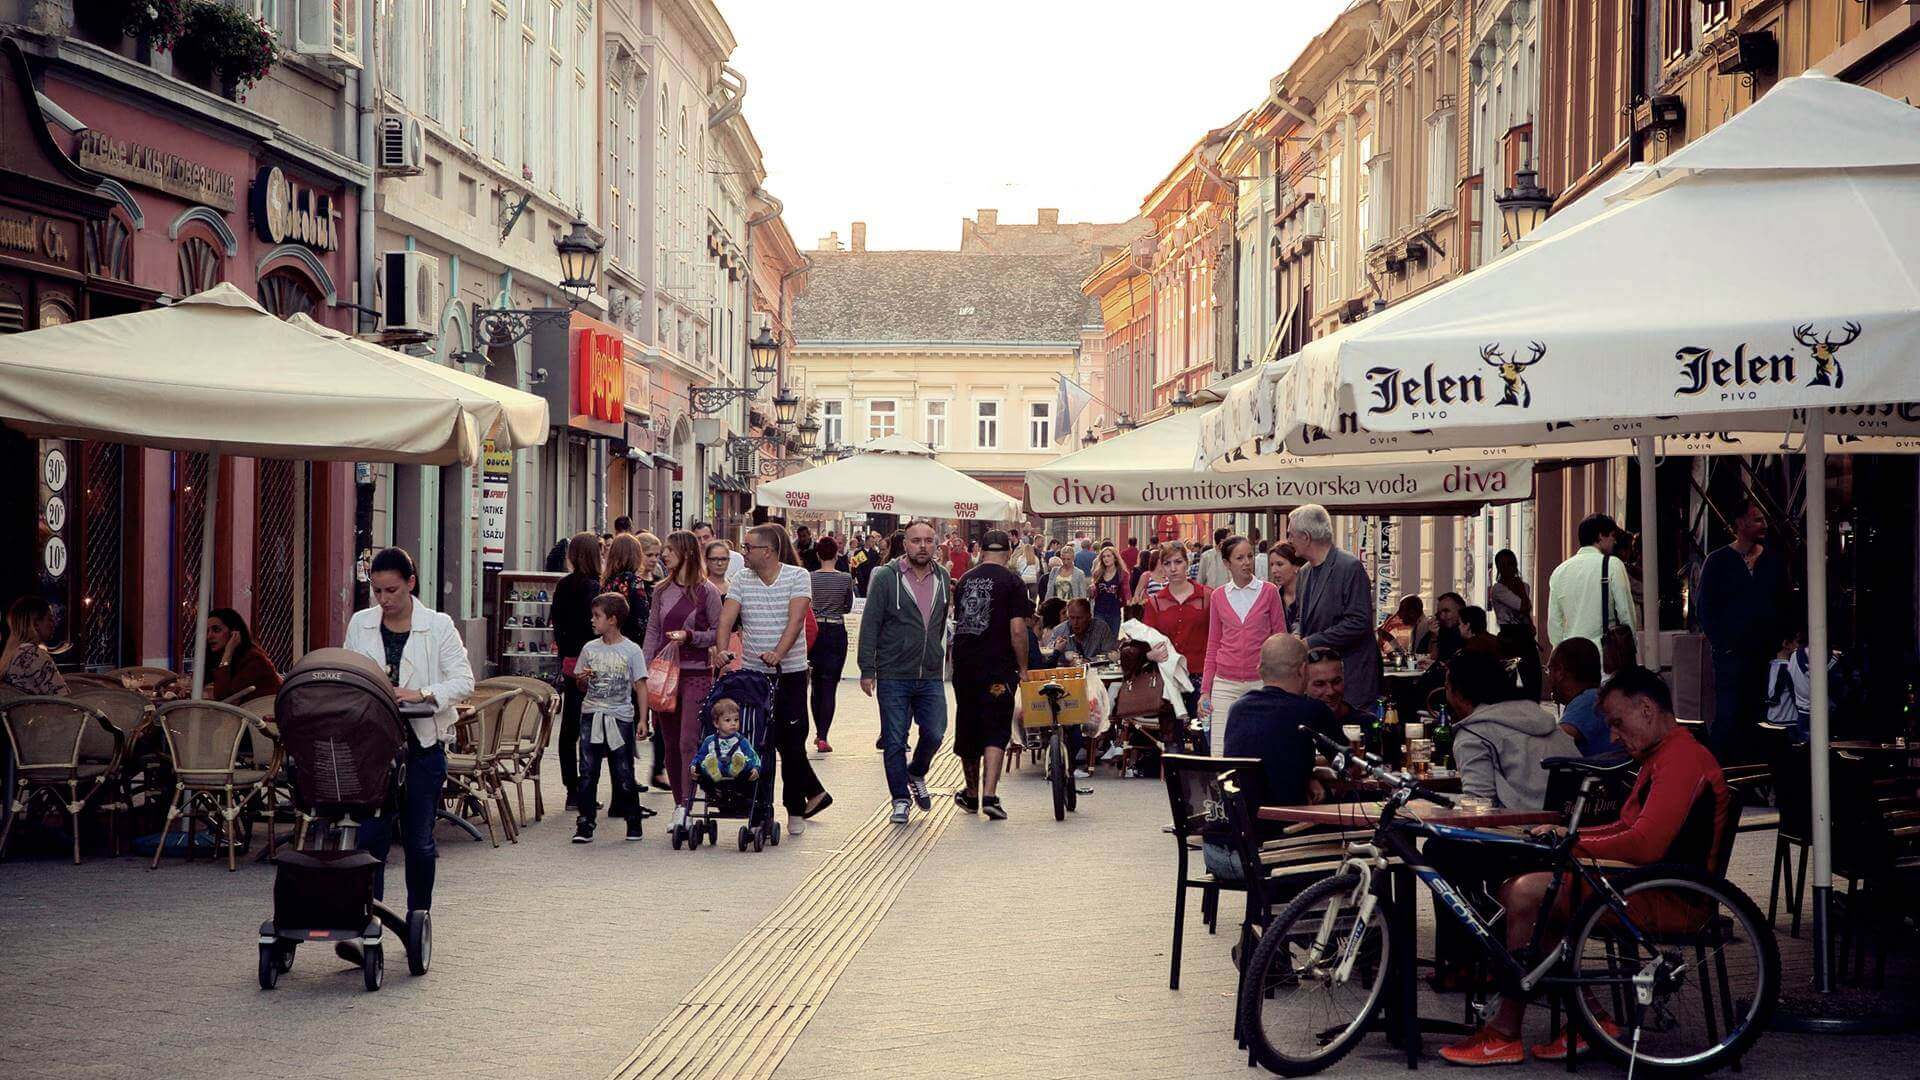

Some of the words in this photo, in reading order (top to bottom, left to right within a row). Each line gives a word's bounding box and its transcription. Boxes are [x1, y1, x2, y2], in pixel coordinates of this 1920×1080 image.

[1674, 342, 1797, 398] Jelen
[1365, 362, 1485, 416] Jelen
[1721, 391, 1757, 401] PIVO
[1412, 410, 1447, 420] PIVO
[1443, 464, 1507, 493] diva
[1052, 477, 1115, 506] diva
[1142, 477, 1269, 502] durmitorska
[1276, 475, 1361, 496] izvorska
[1366, 473, 1418, 495] voda
[788, 499, 807, 508] viva
[872, 502, 892, 511] viva
[956, 510, 976, 519] viva
[488, 518, 495, 527] U
[312, 671, 343, 680] STOKKE
